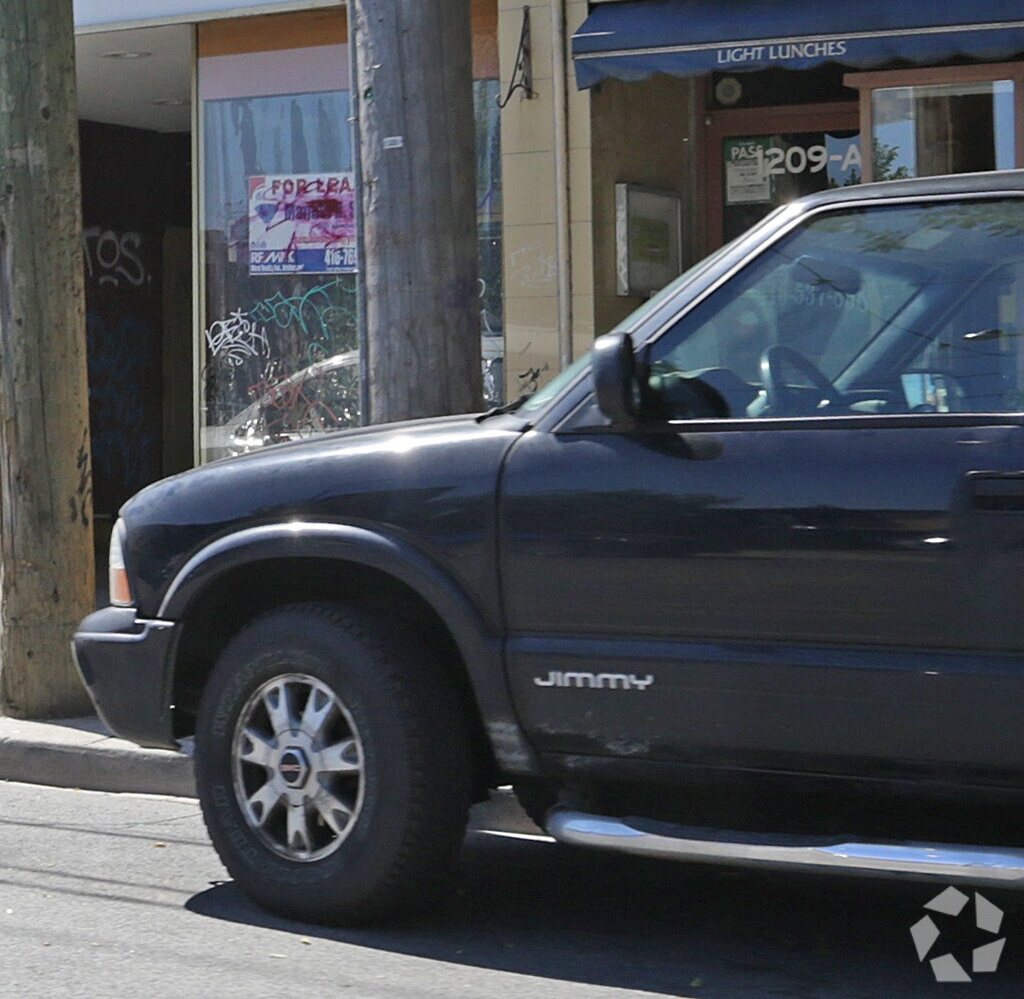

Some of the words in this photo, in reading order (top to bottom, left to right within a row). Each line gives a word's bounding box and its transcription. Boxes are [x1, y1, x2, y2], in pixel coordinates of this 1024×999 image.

[717, 46, 766, 64] LIGHT
[769, 41, 847, 60] LUNCHES
[316, 177, 353, 194] LEA
[533, 671, 654, 691] JIMMY
